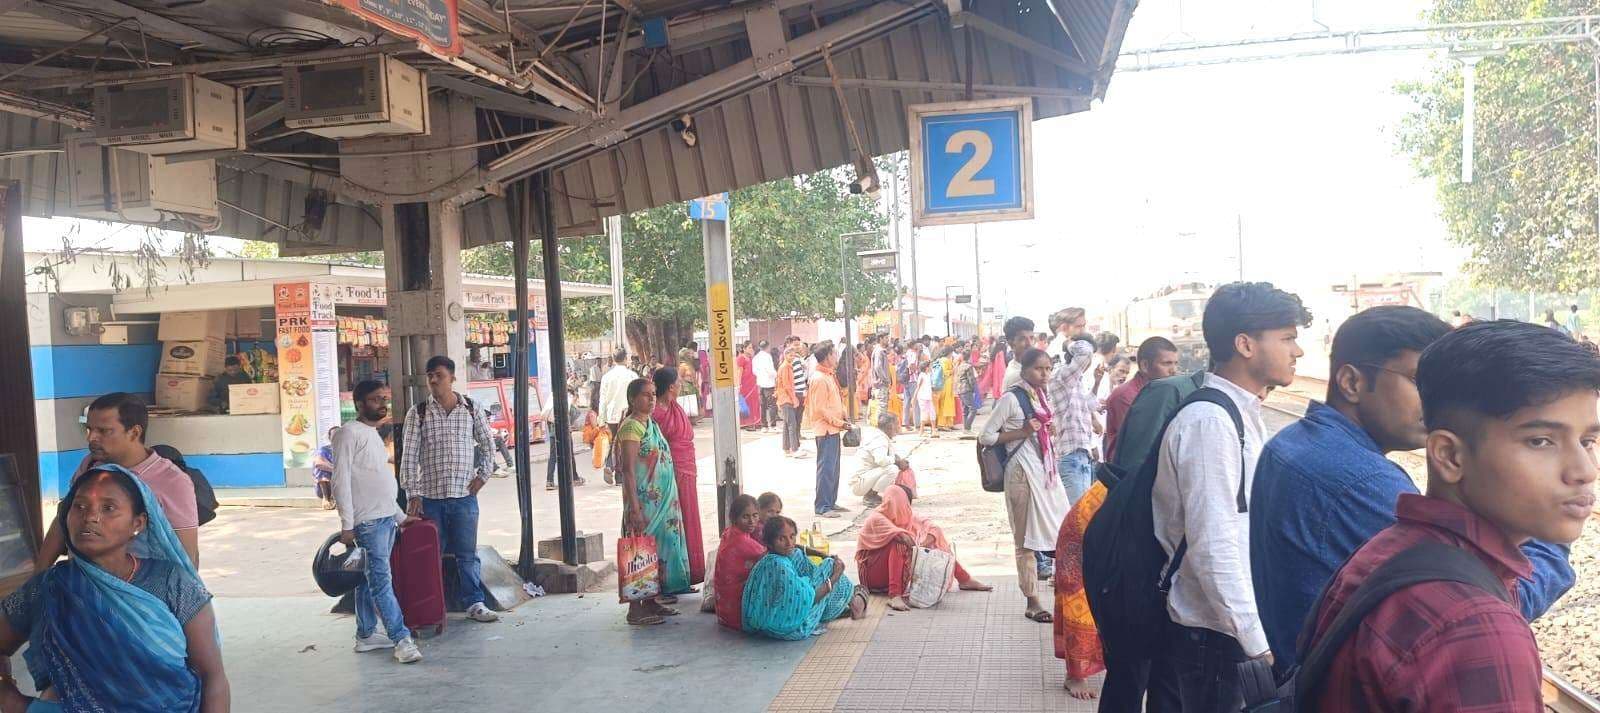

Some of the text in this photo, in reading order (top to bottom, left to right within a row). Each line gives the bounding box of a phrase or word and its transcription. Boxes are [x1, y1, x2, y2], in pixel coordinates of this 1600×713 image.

[945, 130, 995, 198] 2
[345, 286, 371, 298] Food
[313, 301, 332, 310] Food
[312, 311, 334, 319] Track
[279, 317, 308, 326] PRK
